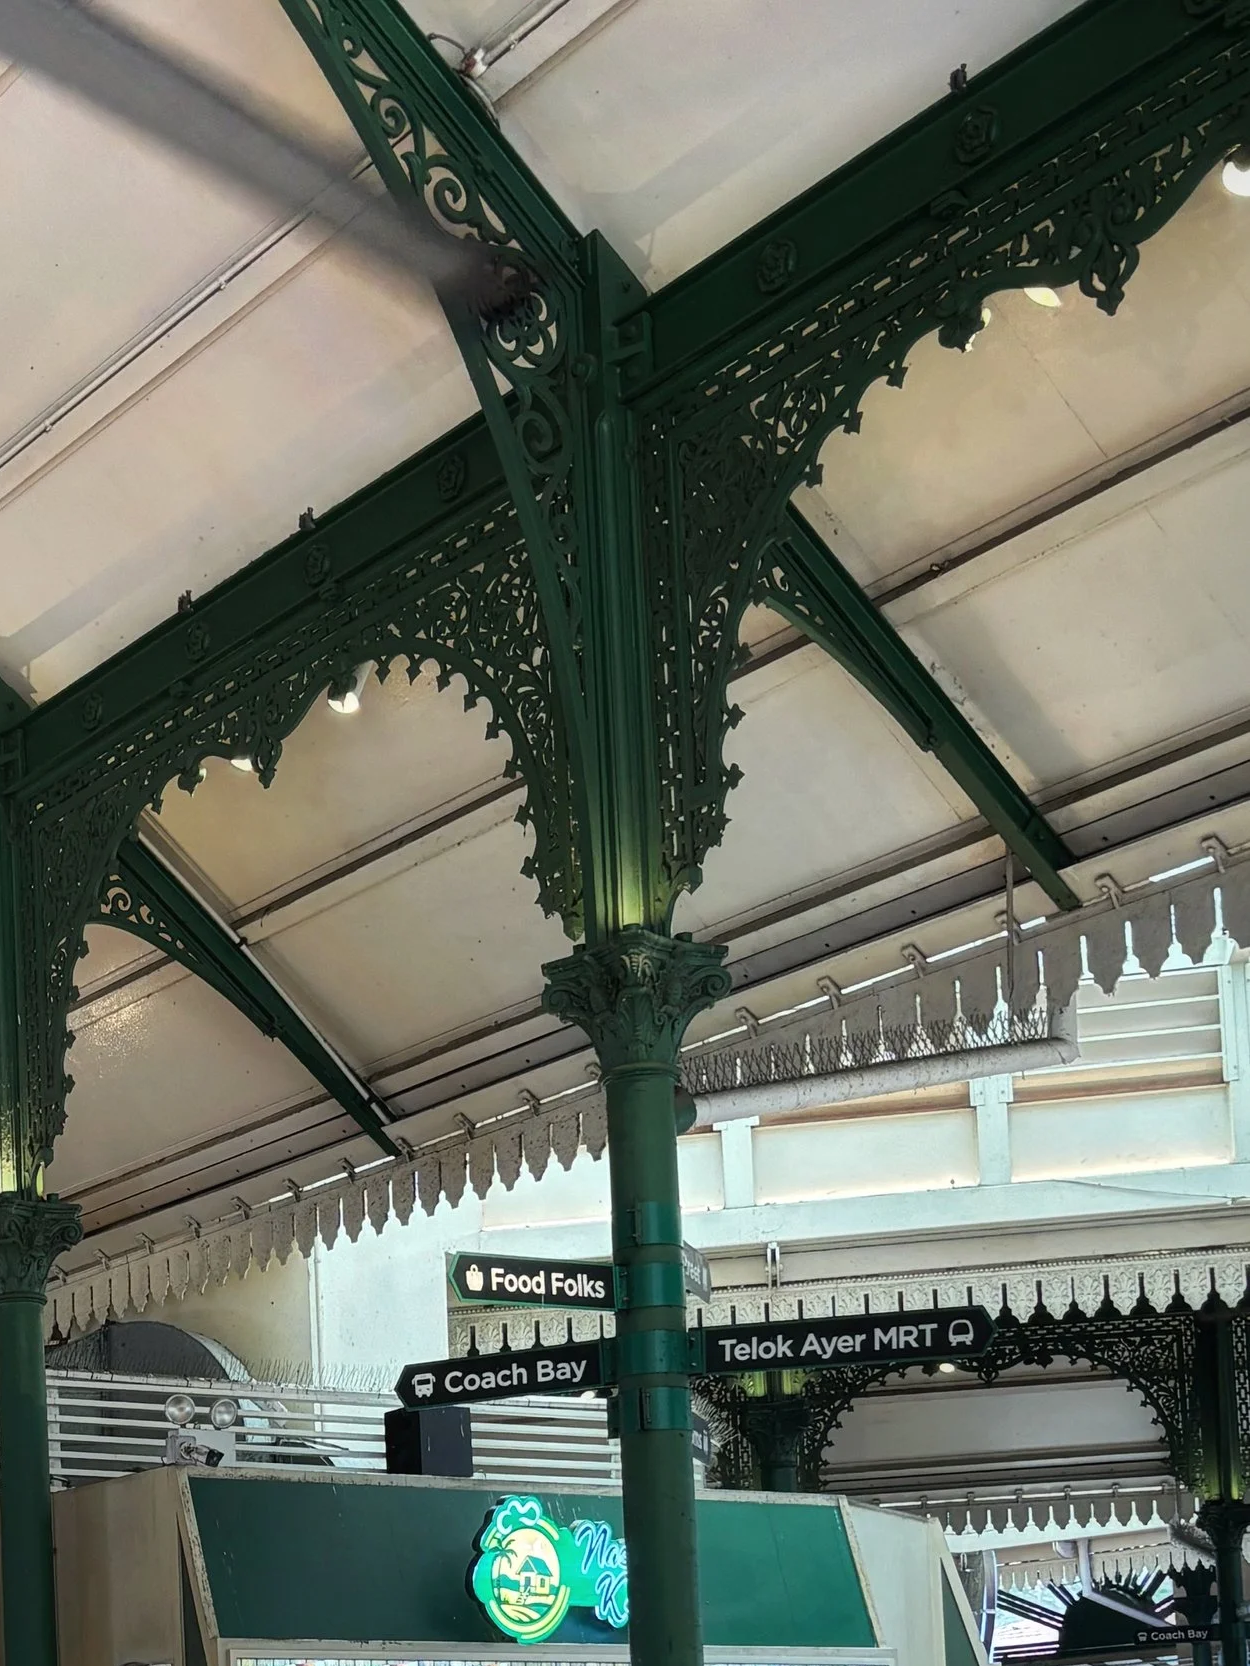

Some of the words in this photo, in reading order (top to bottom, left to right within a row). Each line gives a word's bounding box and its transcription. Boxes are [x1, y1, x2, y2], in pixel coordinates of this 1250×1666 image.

[491, 1268, 546, 1295] Food
[551, 1272, 606, 1299] Folks
[718, 1334, 794, 1362] Telok
[800, 1332, 867, 1360] Ayer
[874, 1323, 938, 1350] MRT
[444, 1362, 528, 1394] Coach
[536, 1359, 587, 1384] Bay
[1150, 1629, 1185, 1641] Coach
[1187, 1628, 1209, 1640] Bay
